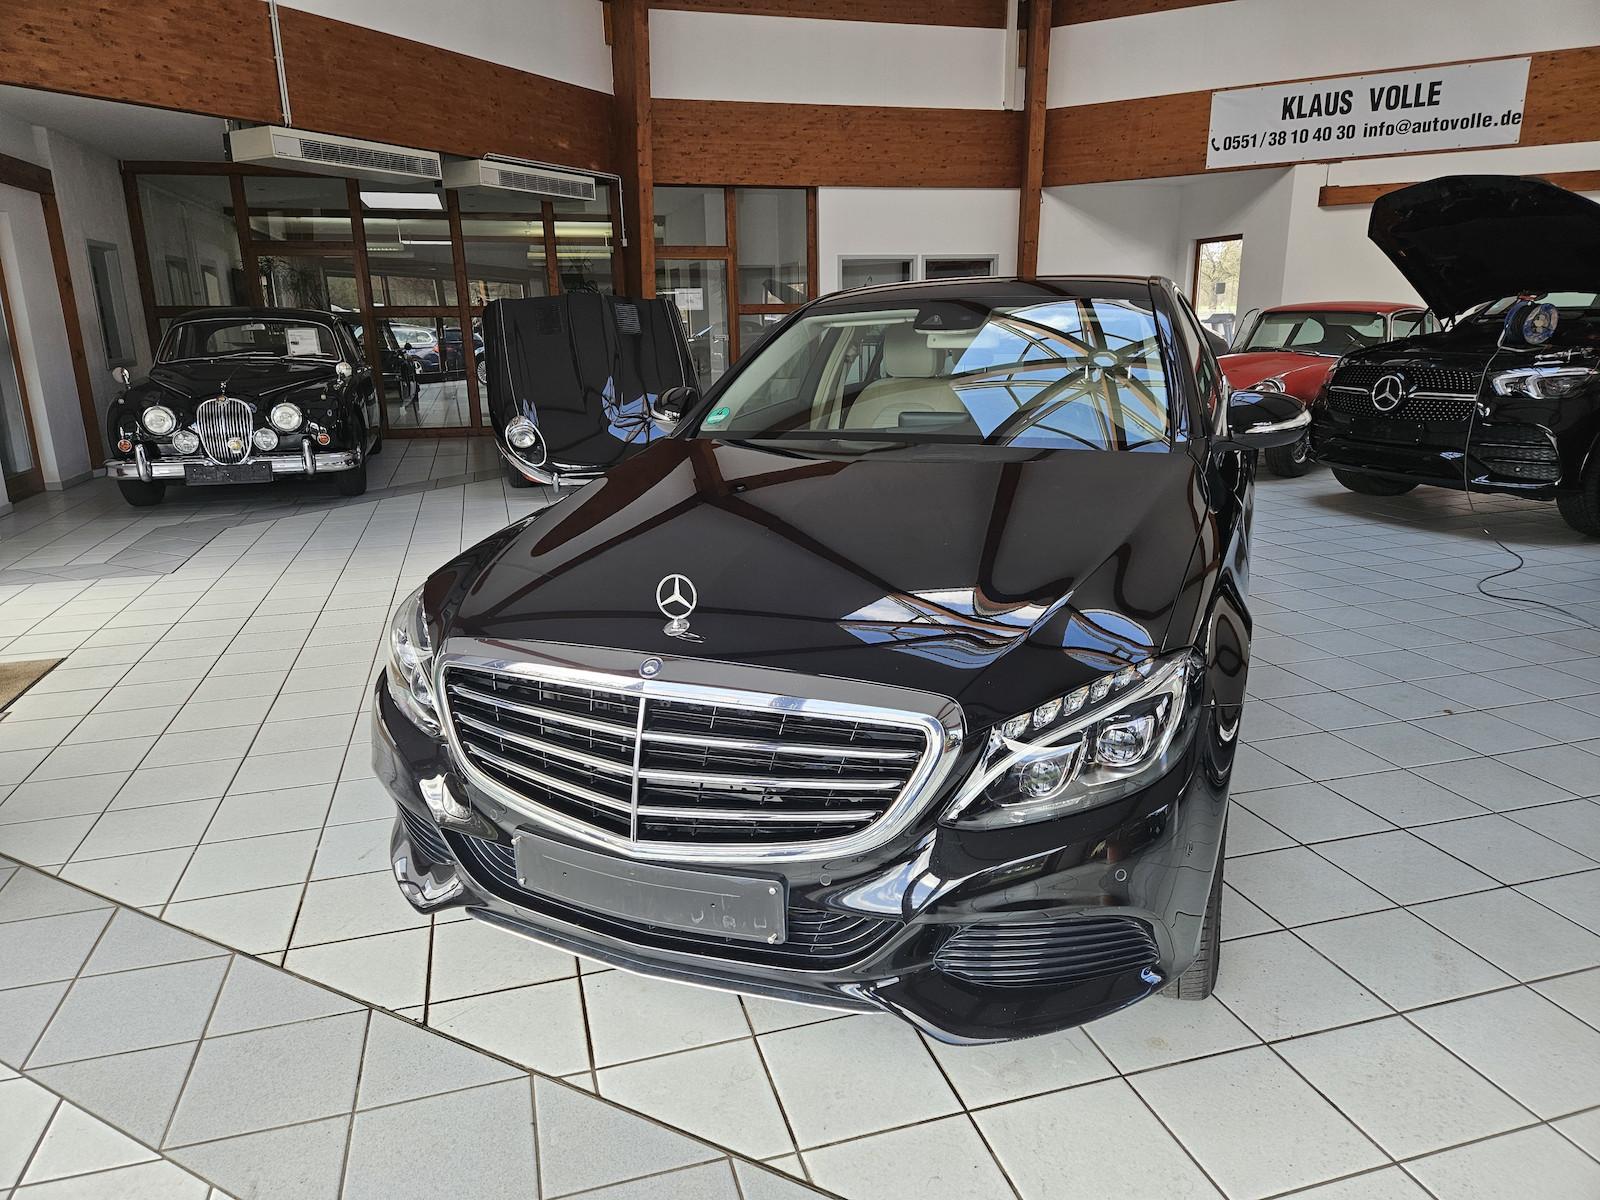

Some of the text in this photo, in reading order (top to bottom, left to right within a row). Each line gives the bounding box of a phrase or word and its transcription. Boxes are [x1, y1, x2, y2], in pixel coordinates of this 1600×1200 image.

[1281, 80, 1443, 121] KLAUS VOLLE
[1290, 128, 1309, 144] 10
[1312, 126, 1333, 142] 40
[1336, 124, 1356, 140] 30
[1362, 109, 1522, 139] info@autovolle.de
